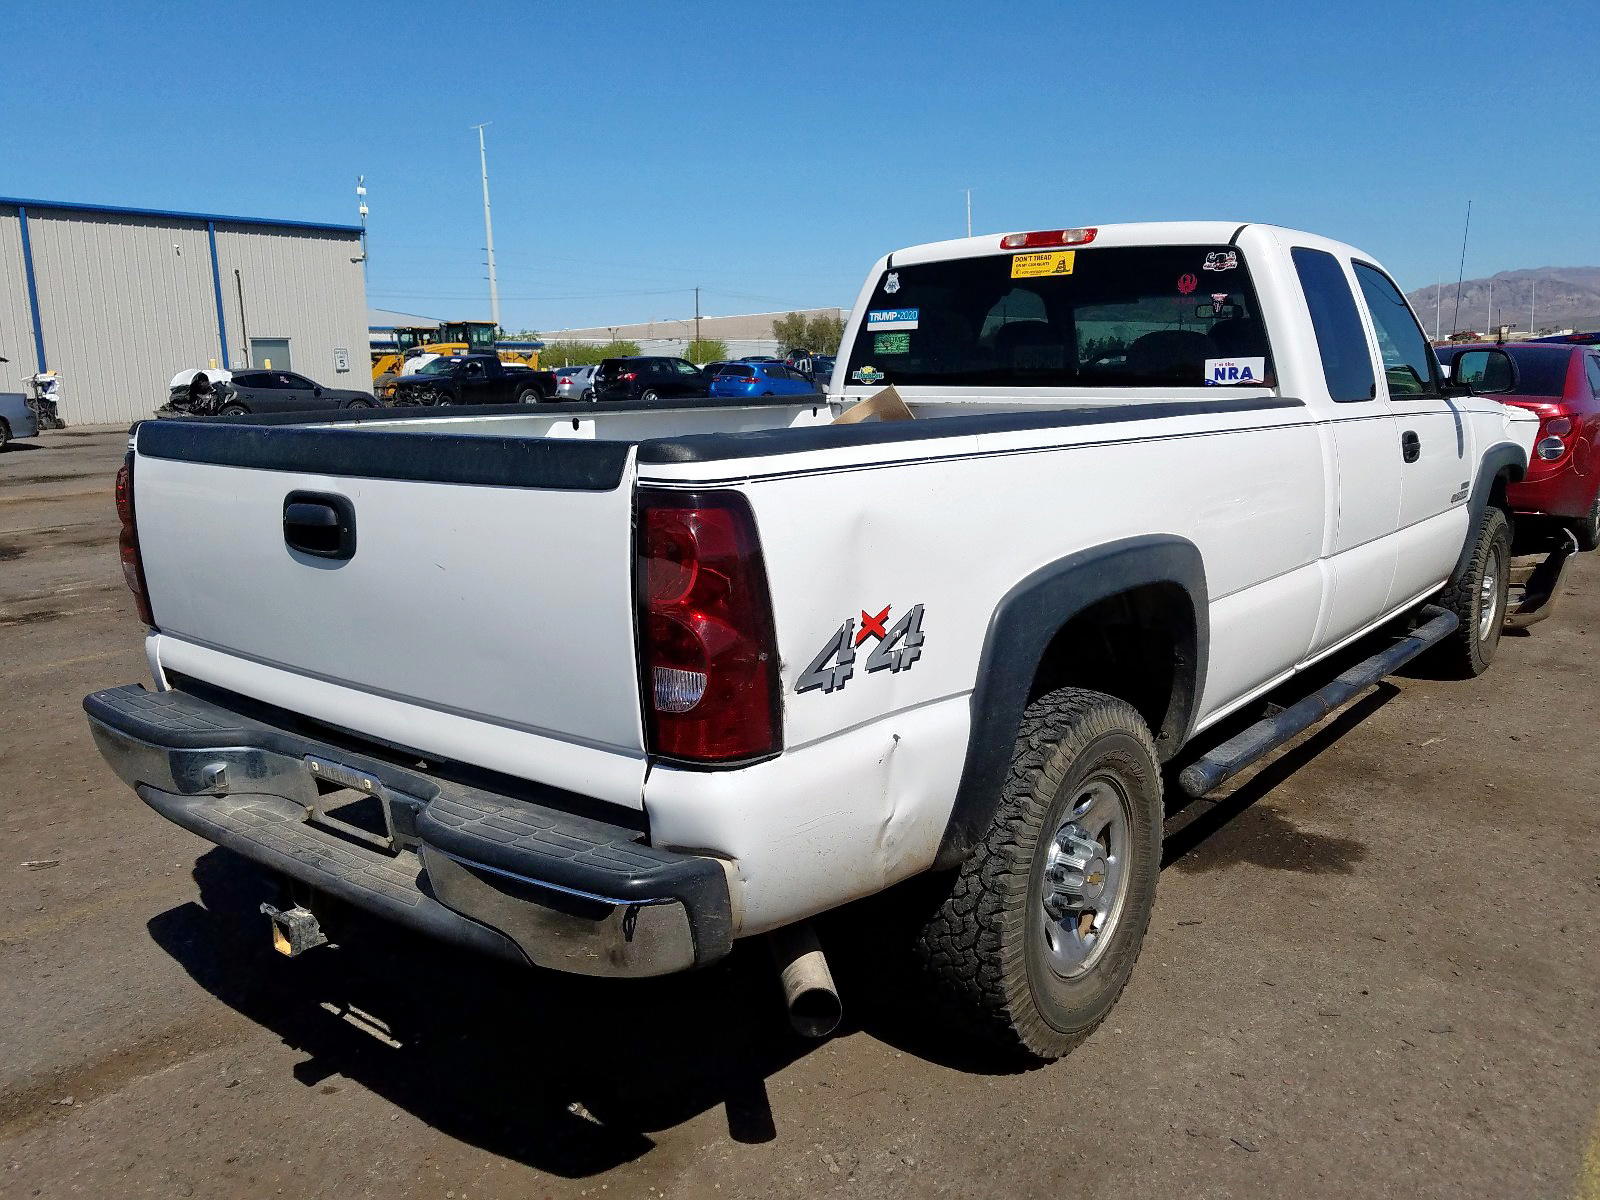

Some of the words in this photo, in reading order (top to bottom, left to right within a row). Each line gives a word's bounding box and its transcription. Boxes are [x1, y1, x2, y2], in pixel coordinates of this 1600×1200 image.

[870, 312, 897, 322] TRUMP
[900, 310, 918, 320] 2020
[339, 359, 346, 368] 5
[1214, 366, 1254, 381] NRA
